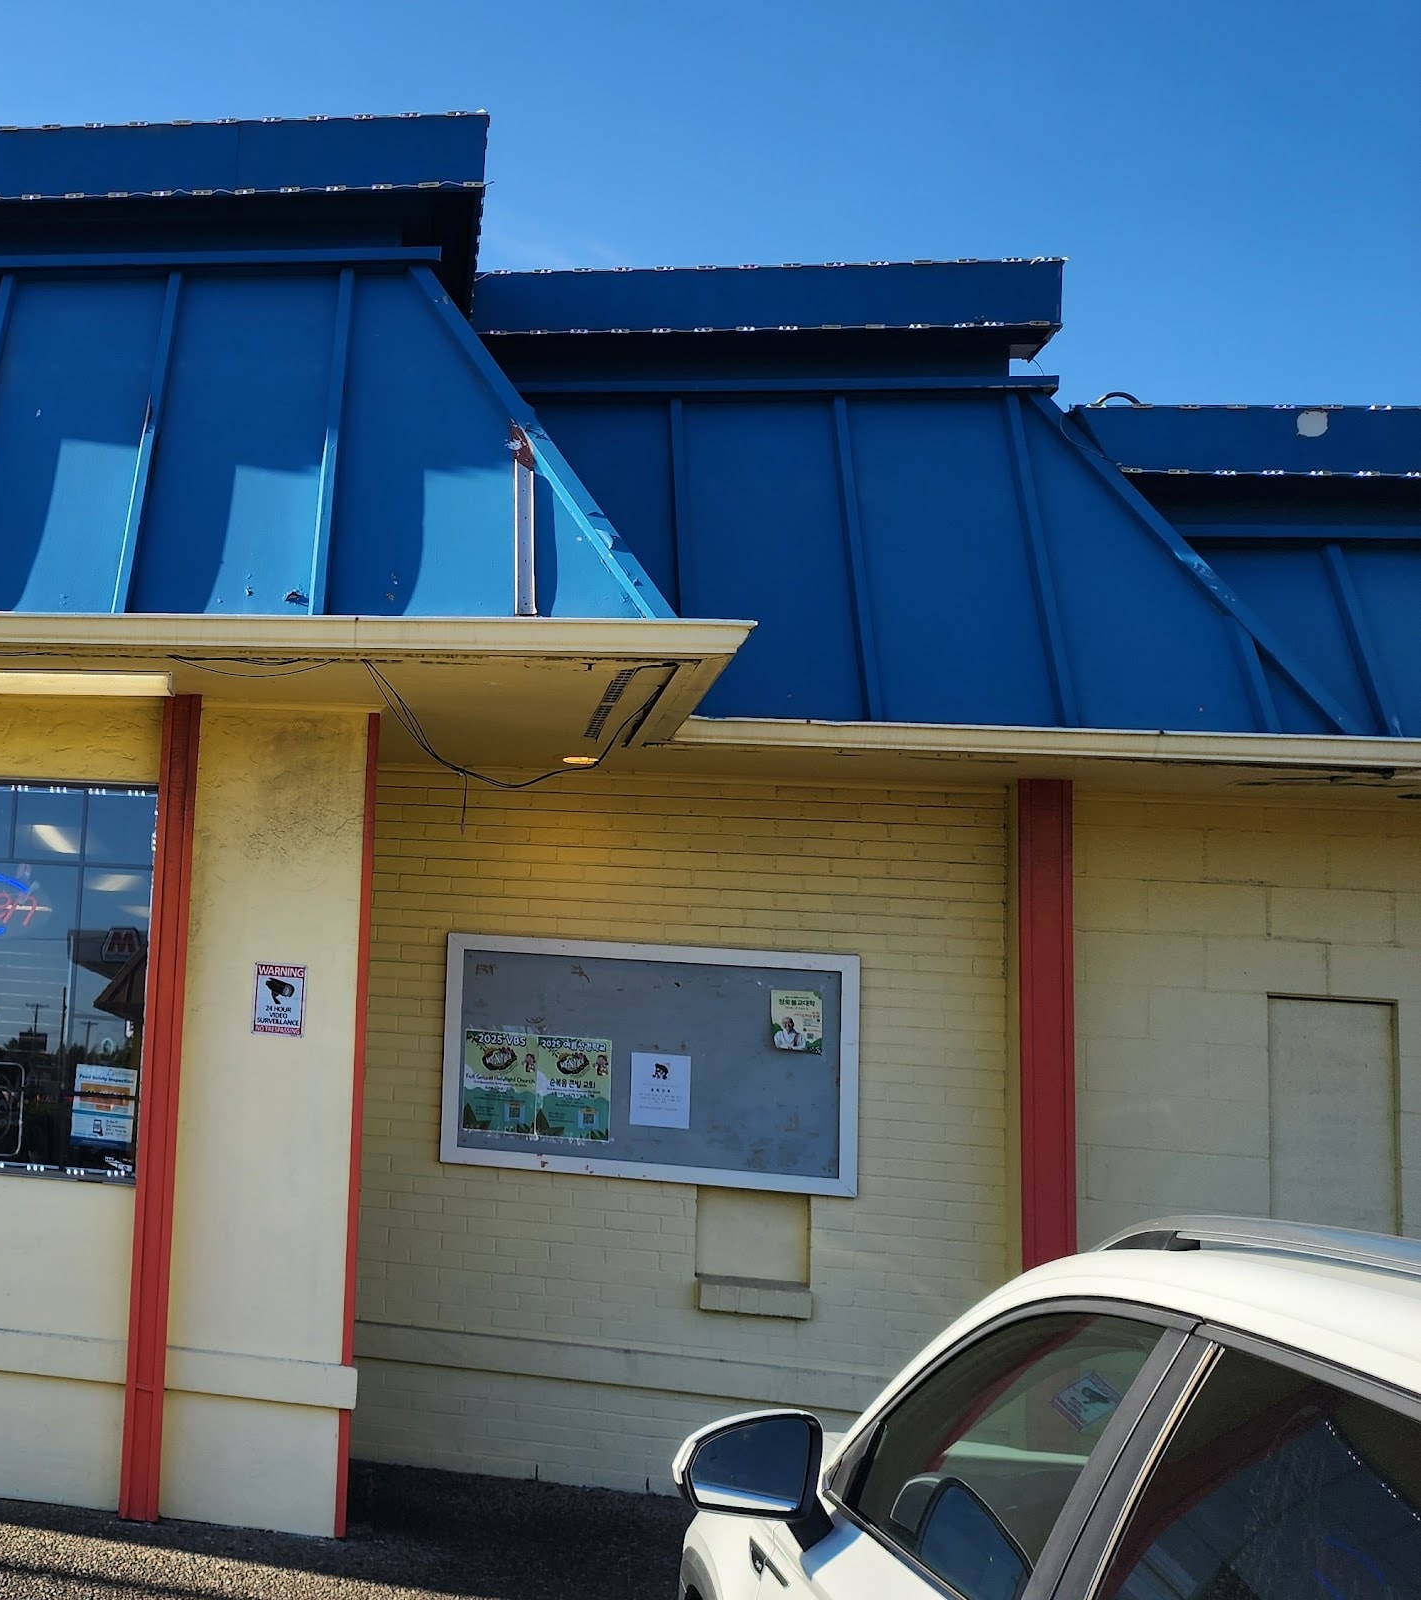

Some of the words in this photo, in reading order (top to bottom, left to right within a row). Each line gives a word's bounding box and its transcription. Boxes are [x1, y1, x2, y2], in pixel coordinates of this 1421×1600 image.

[258, 965, 305, 978] WARNING
[257, 1017, 299, 1026] SURVEILLANCE
[265, 1026, 300, 1035] TRESPASSING
[479, 1034, 503, 1044] 2025
[506, 1036, 526, 1046] VBS
